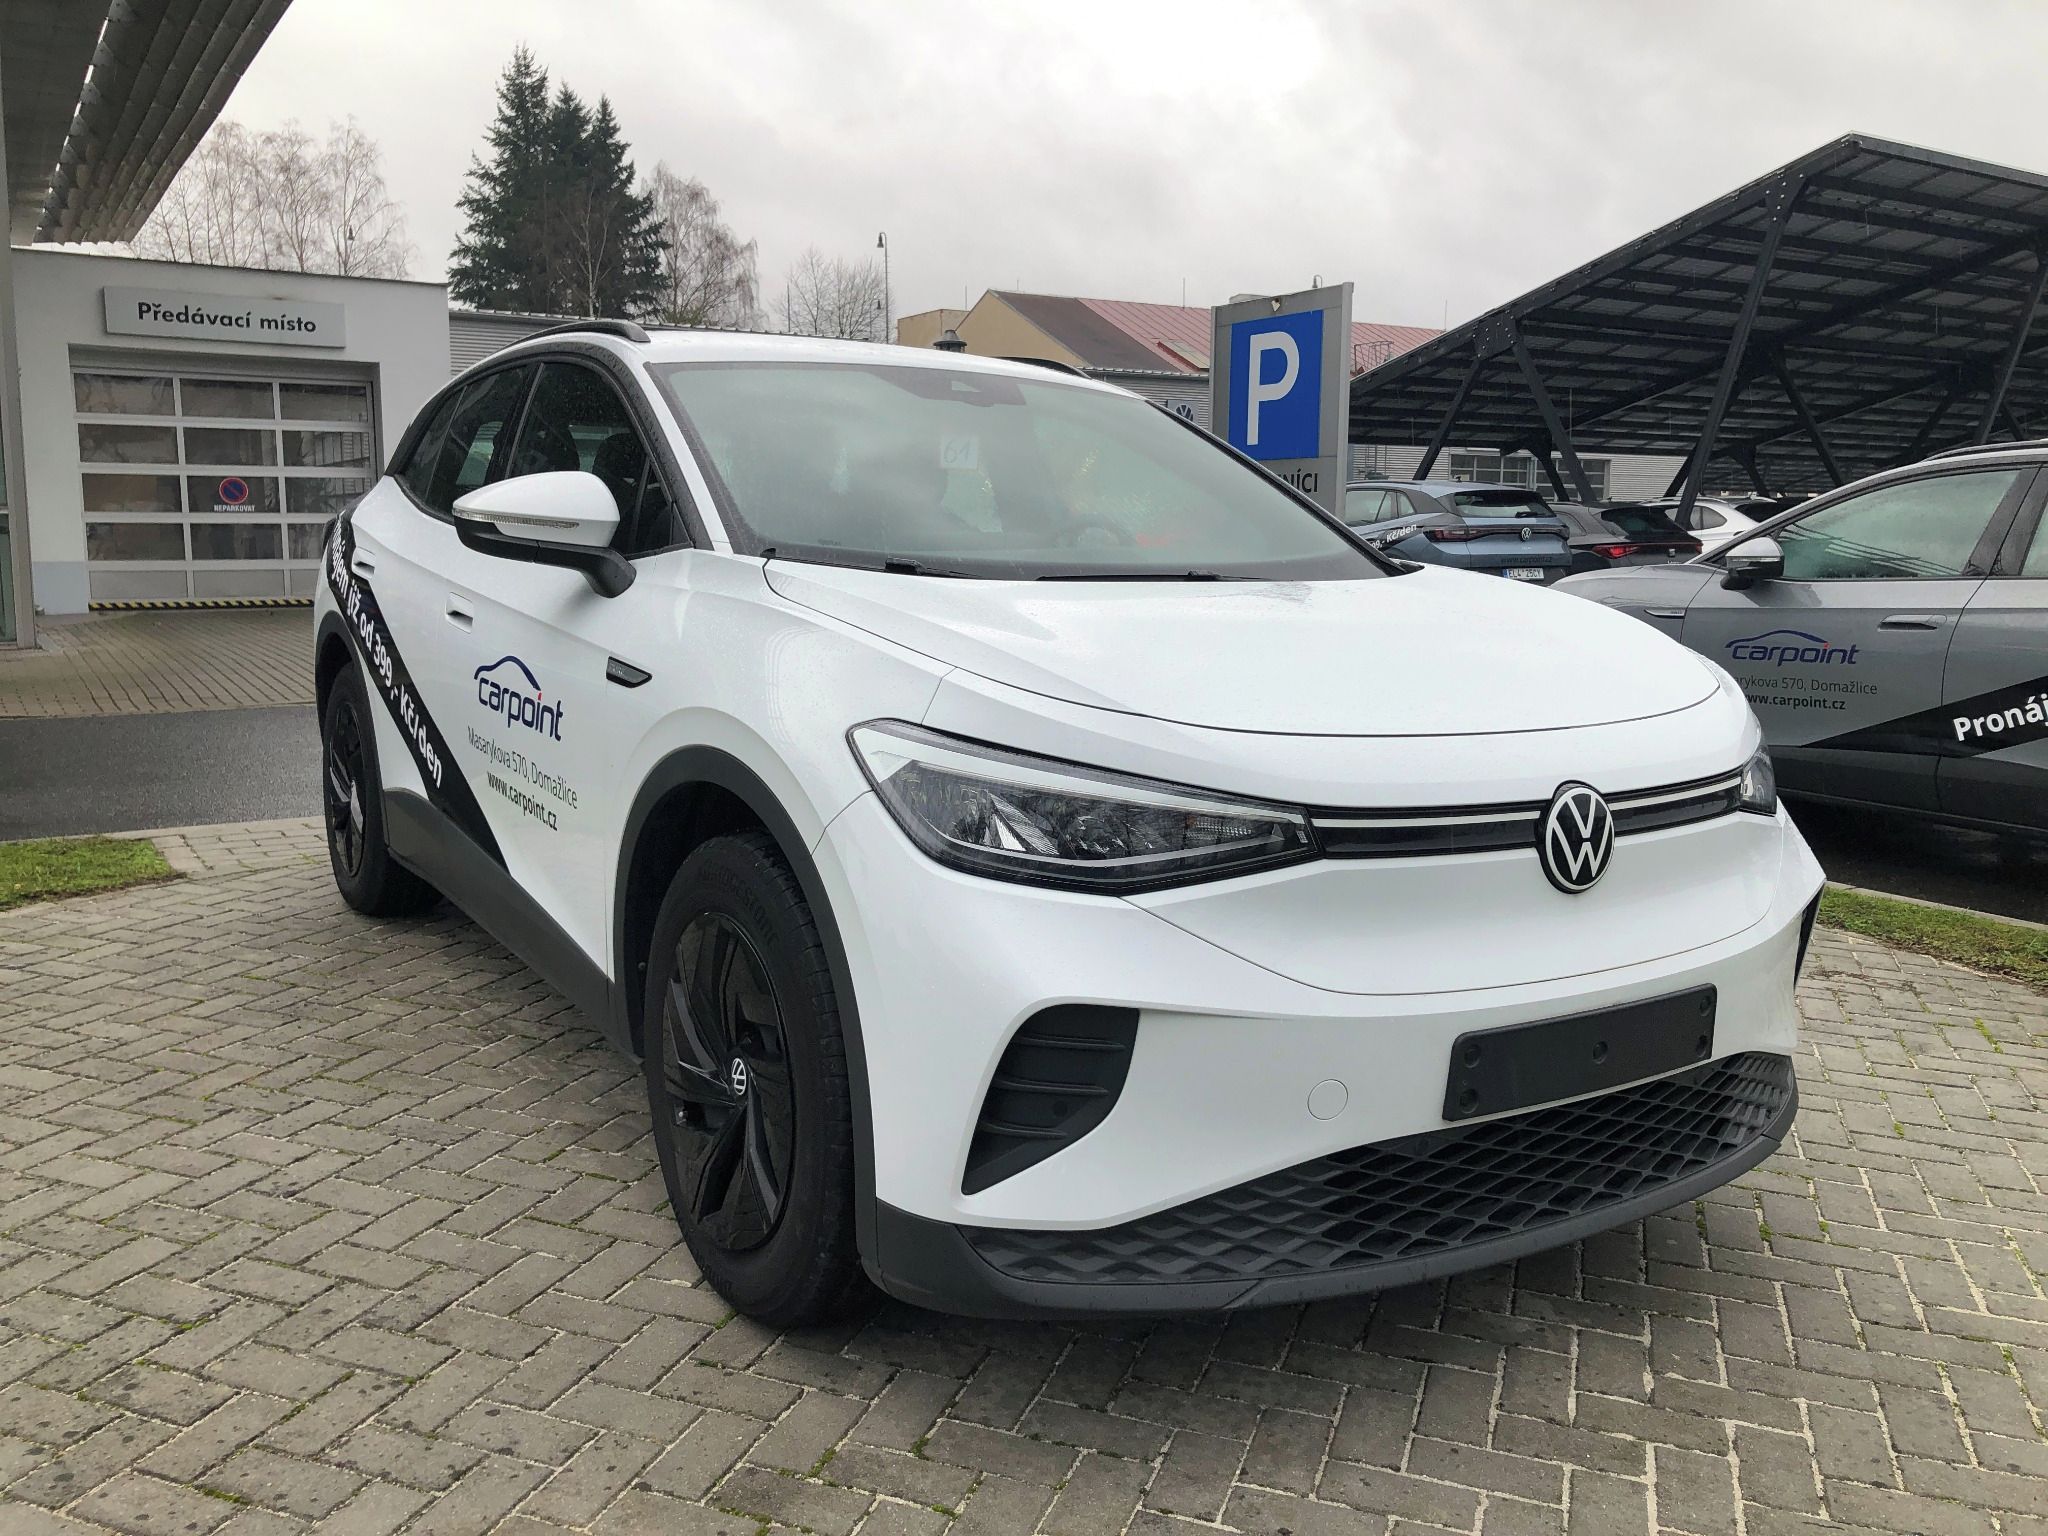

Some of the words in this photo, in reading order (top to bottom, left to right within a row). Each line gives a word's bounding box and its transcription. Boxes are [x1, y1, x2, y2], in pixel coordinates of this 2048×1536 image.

[137, 302, 251, 328] Předávací
[260, 314, 317, 333] místo
[1247, 331, 1300, 446] P
[213, 504, 255, 512] NEPARKOVAT
[1386, 524, 1417, 543] Kč/den
[1732, 642, 1861, 667] carpoint
[346, 579, 361, 624] již
[360, 612, 375, 652] od
[400, 684, 443, 790] Kč/den
[1781, 677, 1807, 692] 570,
[1811, 679, 1878, 695] Domažlice
[478, 676, 564, 742] carpoint
[467, 725, 511, 769] Masarykova
[511, 751, 531, 783] 570,
[531, 761, 579, 810] Domažlice
[486, 770, 559, 832] www.carpoint.cz
